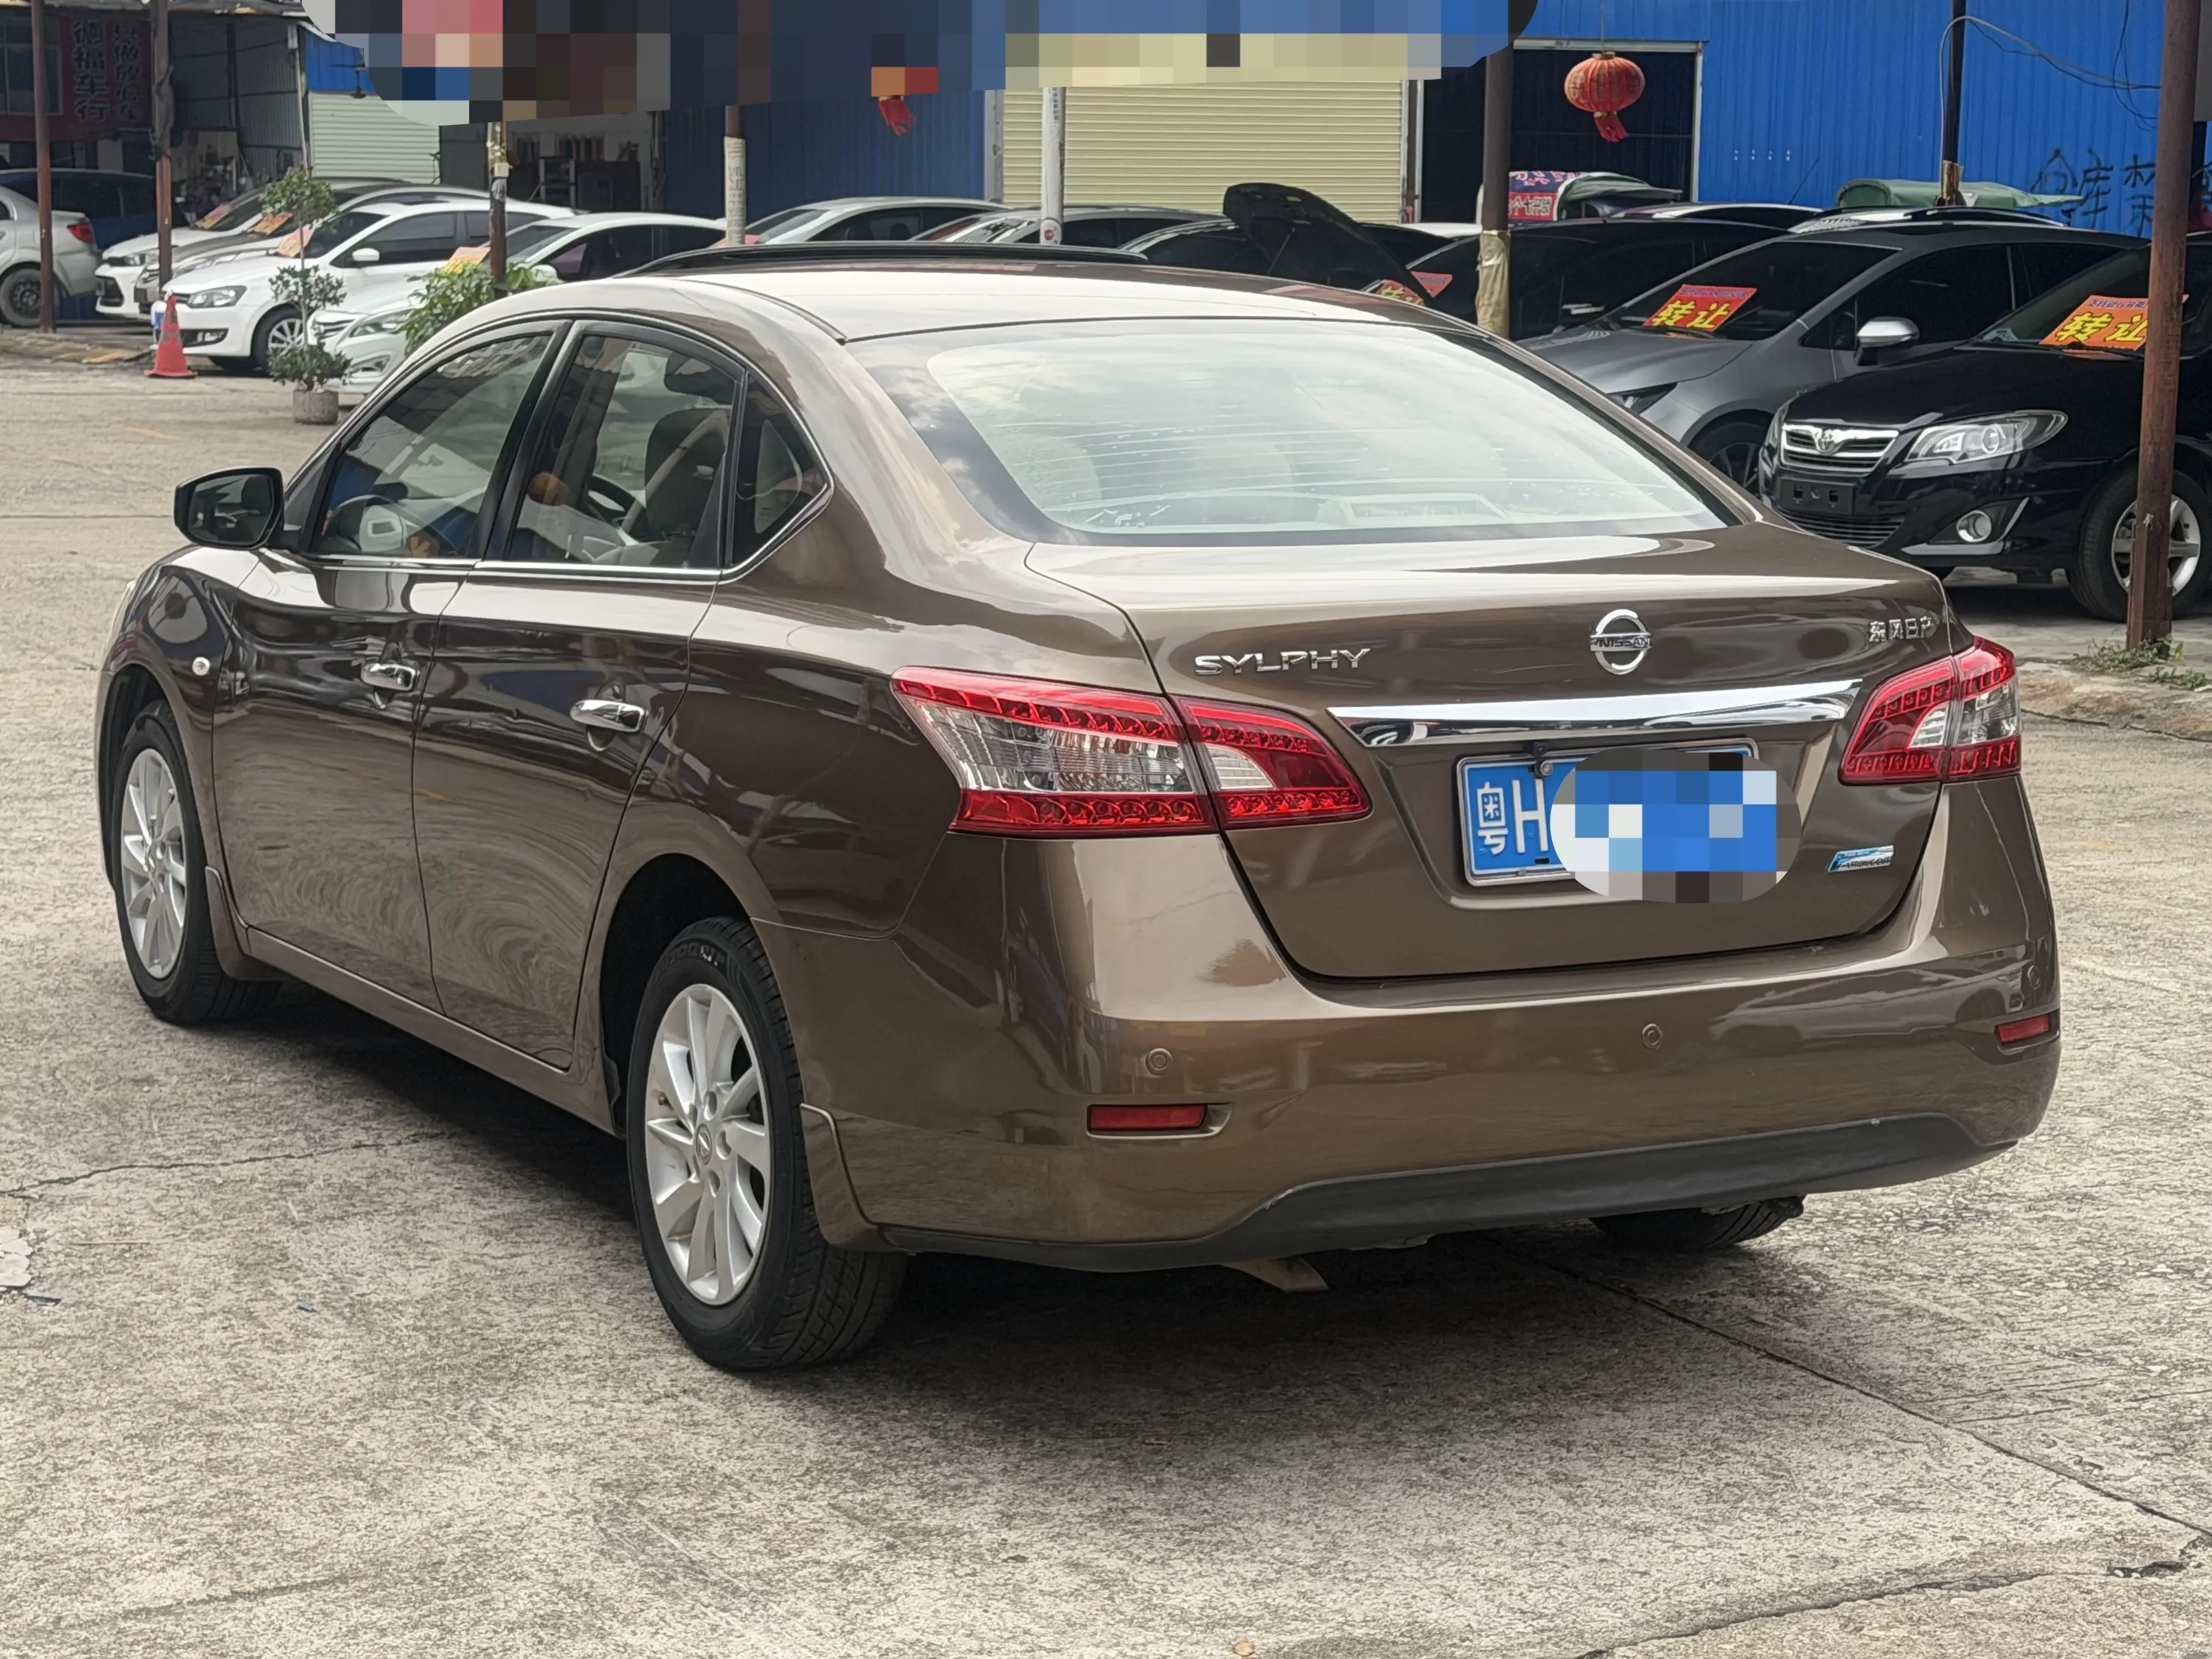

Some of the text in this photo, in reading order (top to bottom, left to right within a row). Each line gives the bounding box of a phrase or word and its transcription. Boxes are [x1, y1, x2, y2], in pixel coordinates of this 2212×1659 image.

[1651, 299, 1731, 328] 转让
[2055, 311, 2147, 342] 转让
[1597, 636, 1649, 648] NISSAN
[1869, 616, 1932, 642] 东风日产
[1193, 647, 1371, 676] SYLPHY
[1476, 777, 1550, 855] 粤H
